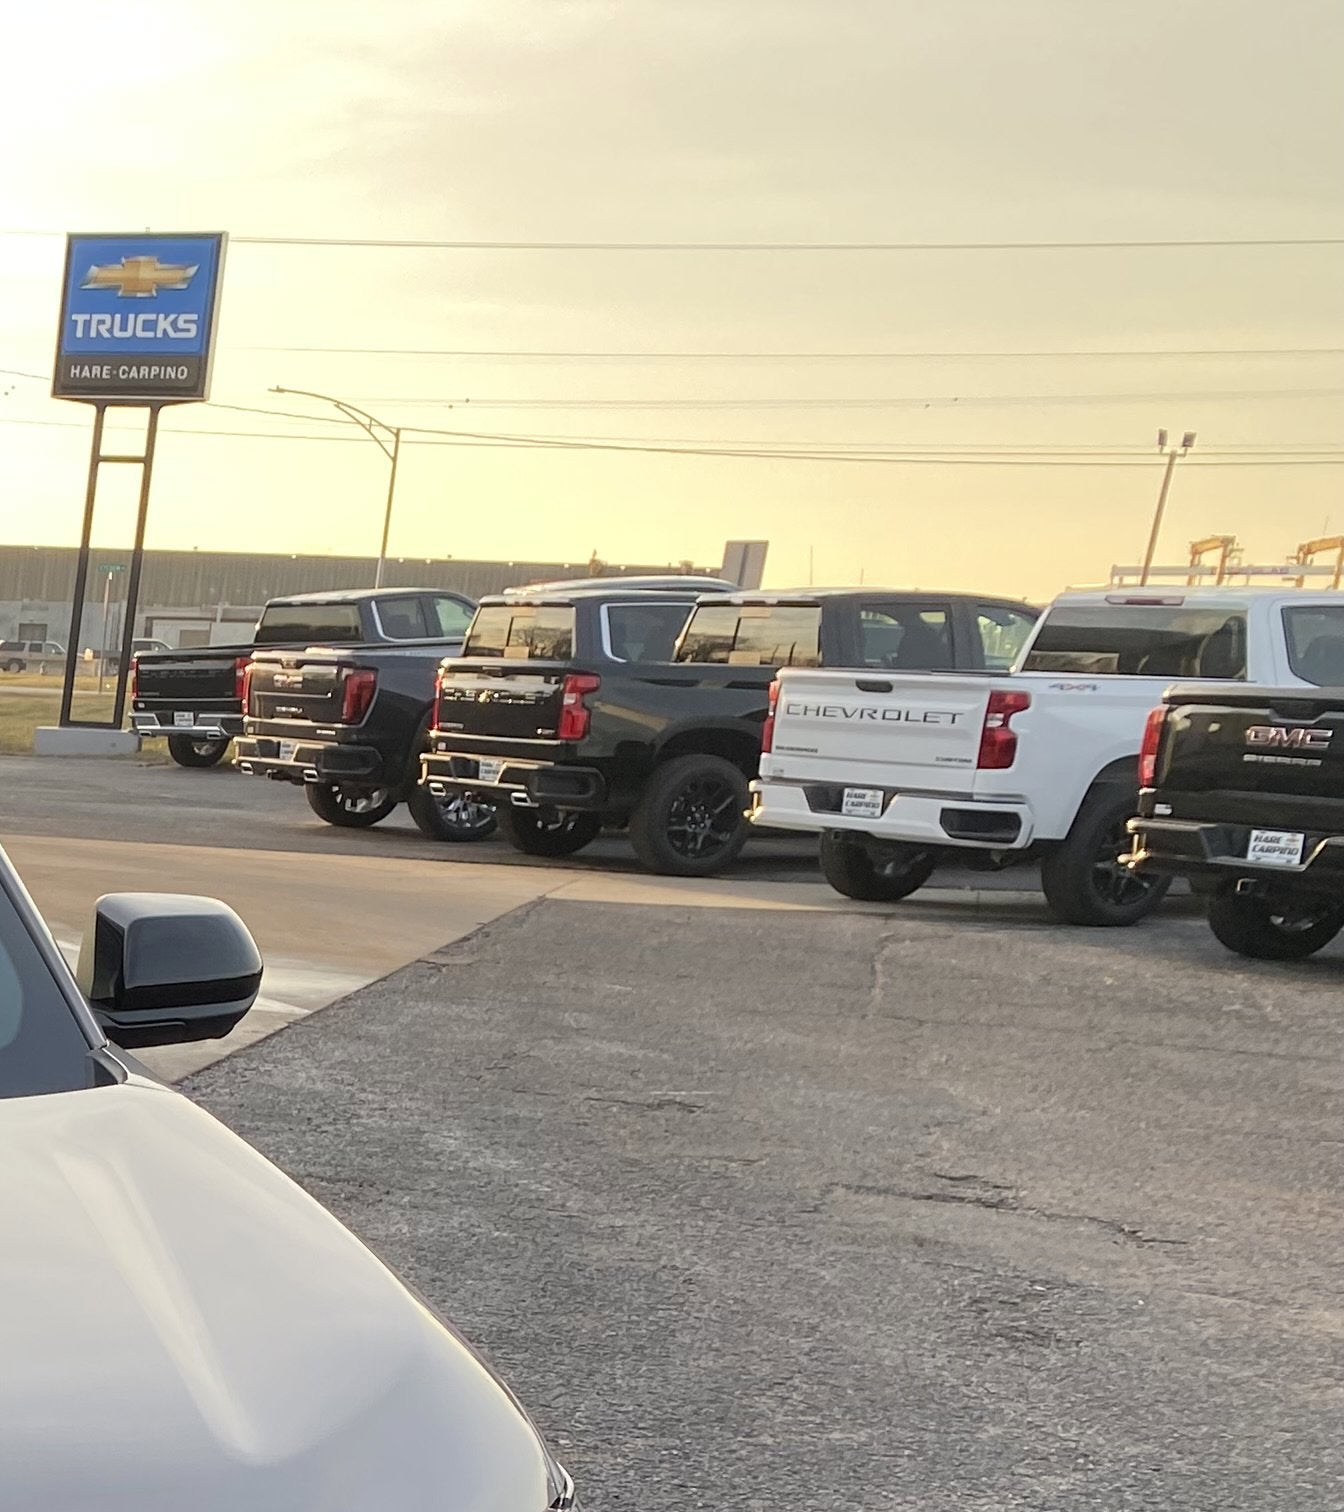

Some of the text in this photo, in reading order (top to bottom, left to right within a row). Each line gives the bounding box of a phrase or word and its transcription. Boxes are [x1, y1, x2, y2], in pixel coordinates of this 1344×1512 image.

[71, 313, 199, 338] TRUCKS
[786, 703, 965, 724] CHEVROLET
[1244, 726, 1333, 749] GMC
[1252, 844, 1299, 856] CARPINO
